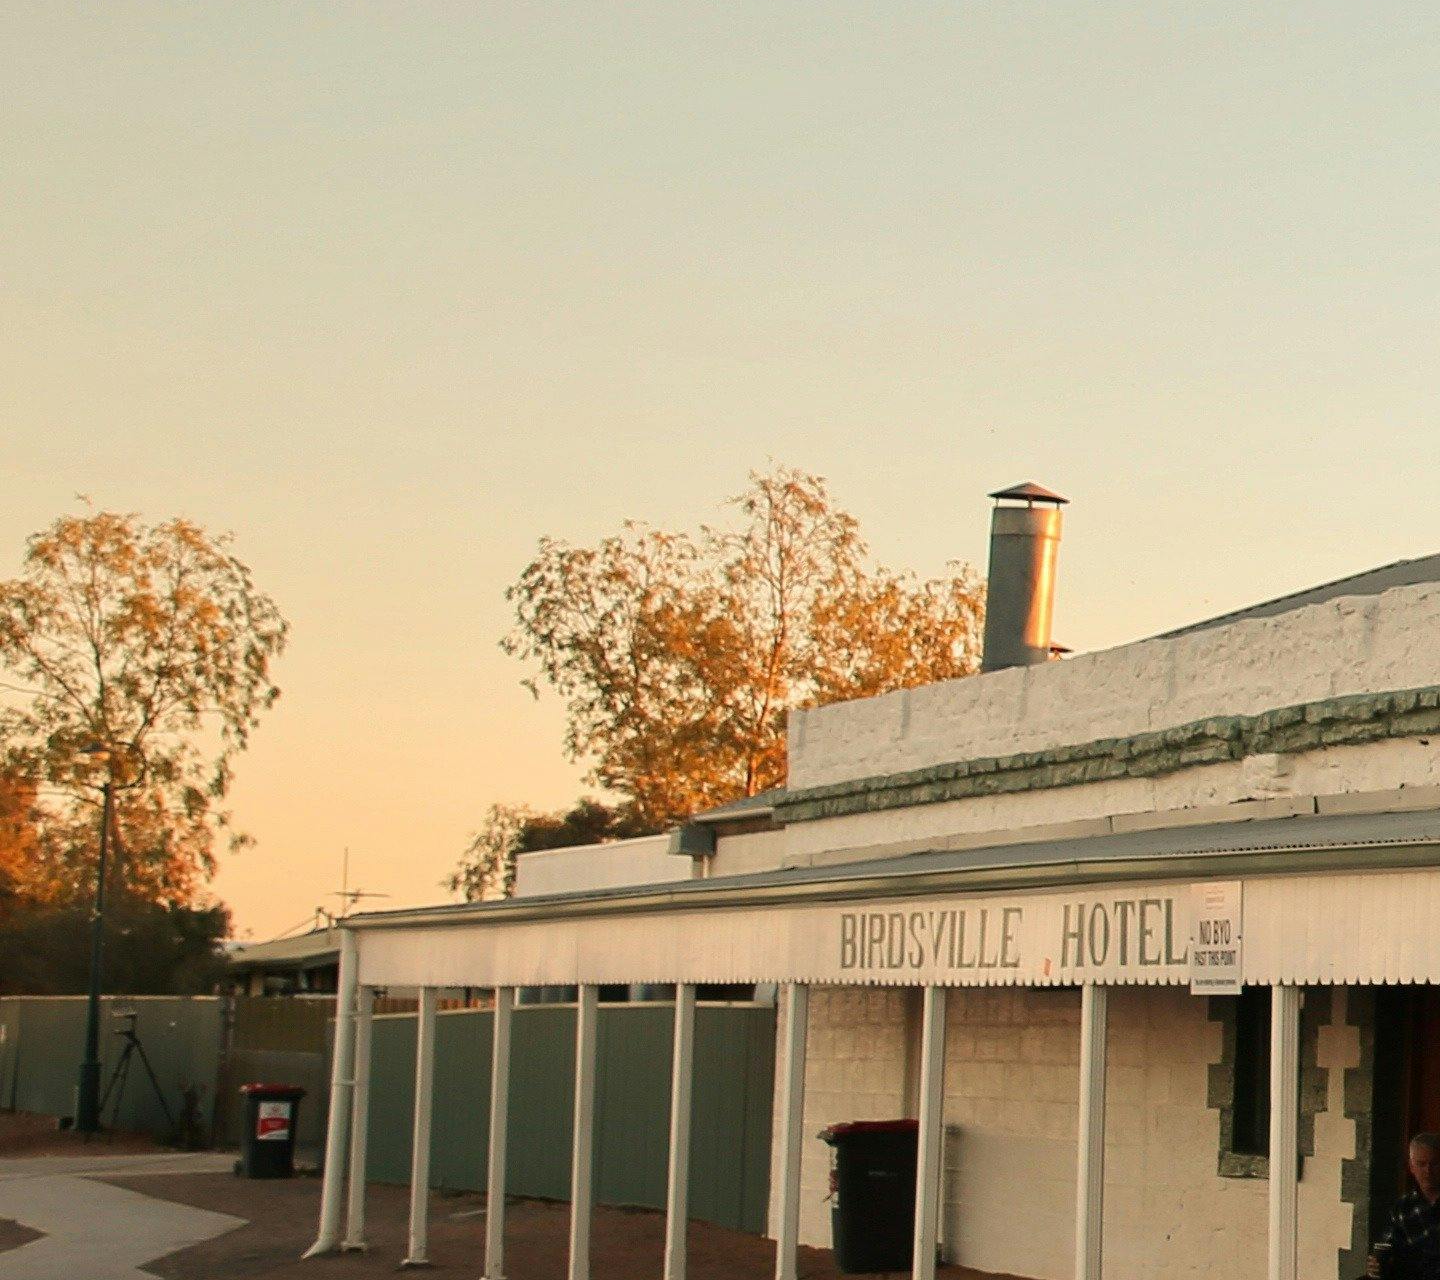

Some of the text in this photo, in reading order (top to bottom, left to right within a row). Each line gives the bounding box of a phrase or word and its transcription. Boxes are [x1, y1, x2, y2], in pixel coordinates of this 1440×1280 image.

[841, 898, 1189, 970] BIRDSVILLE HOTEL
[1199, 919, 1212, 945] NO
